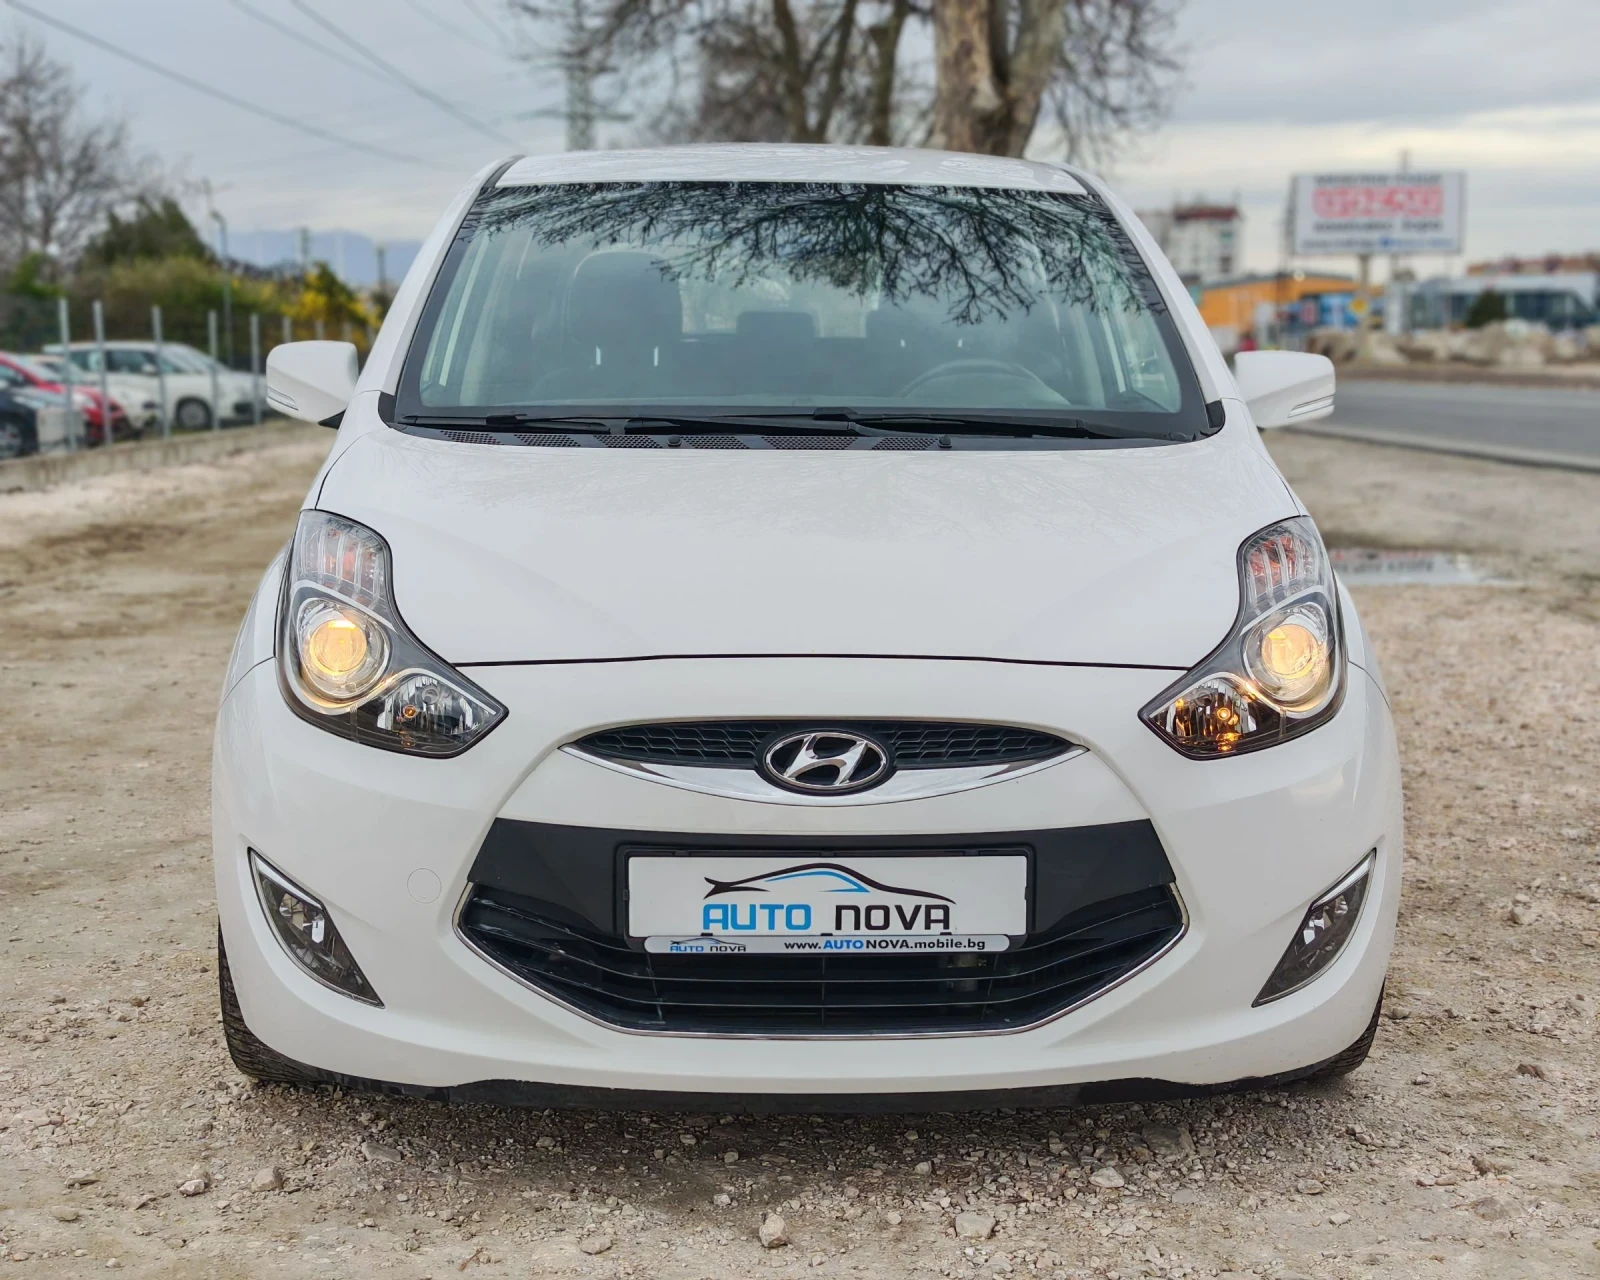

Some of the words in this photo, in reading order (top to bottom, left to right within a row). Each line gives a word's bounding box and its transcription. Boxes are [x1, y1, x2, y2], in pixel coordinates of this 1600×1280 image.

[703, 903, 811, 931] AUTO
[834, 904, 951, 931] NOVA
[669, 945, 705, 953] AUTO
[709, 945, 747, 953] NOVA
[783, 938, 986, 951] www.AUTONOVA.mobile.bg
